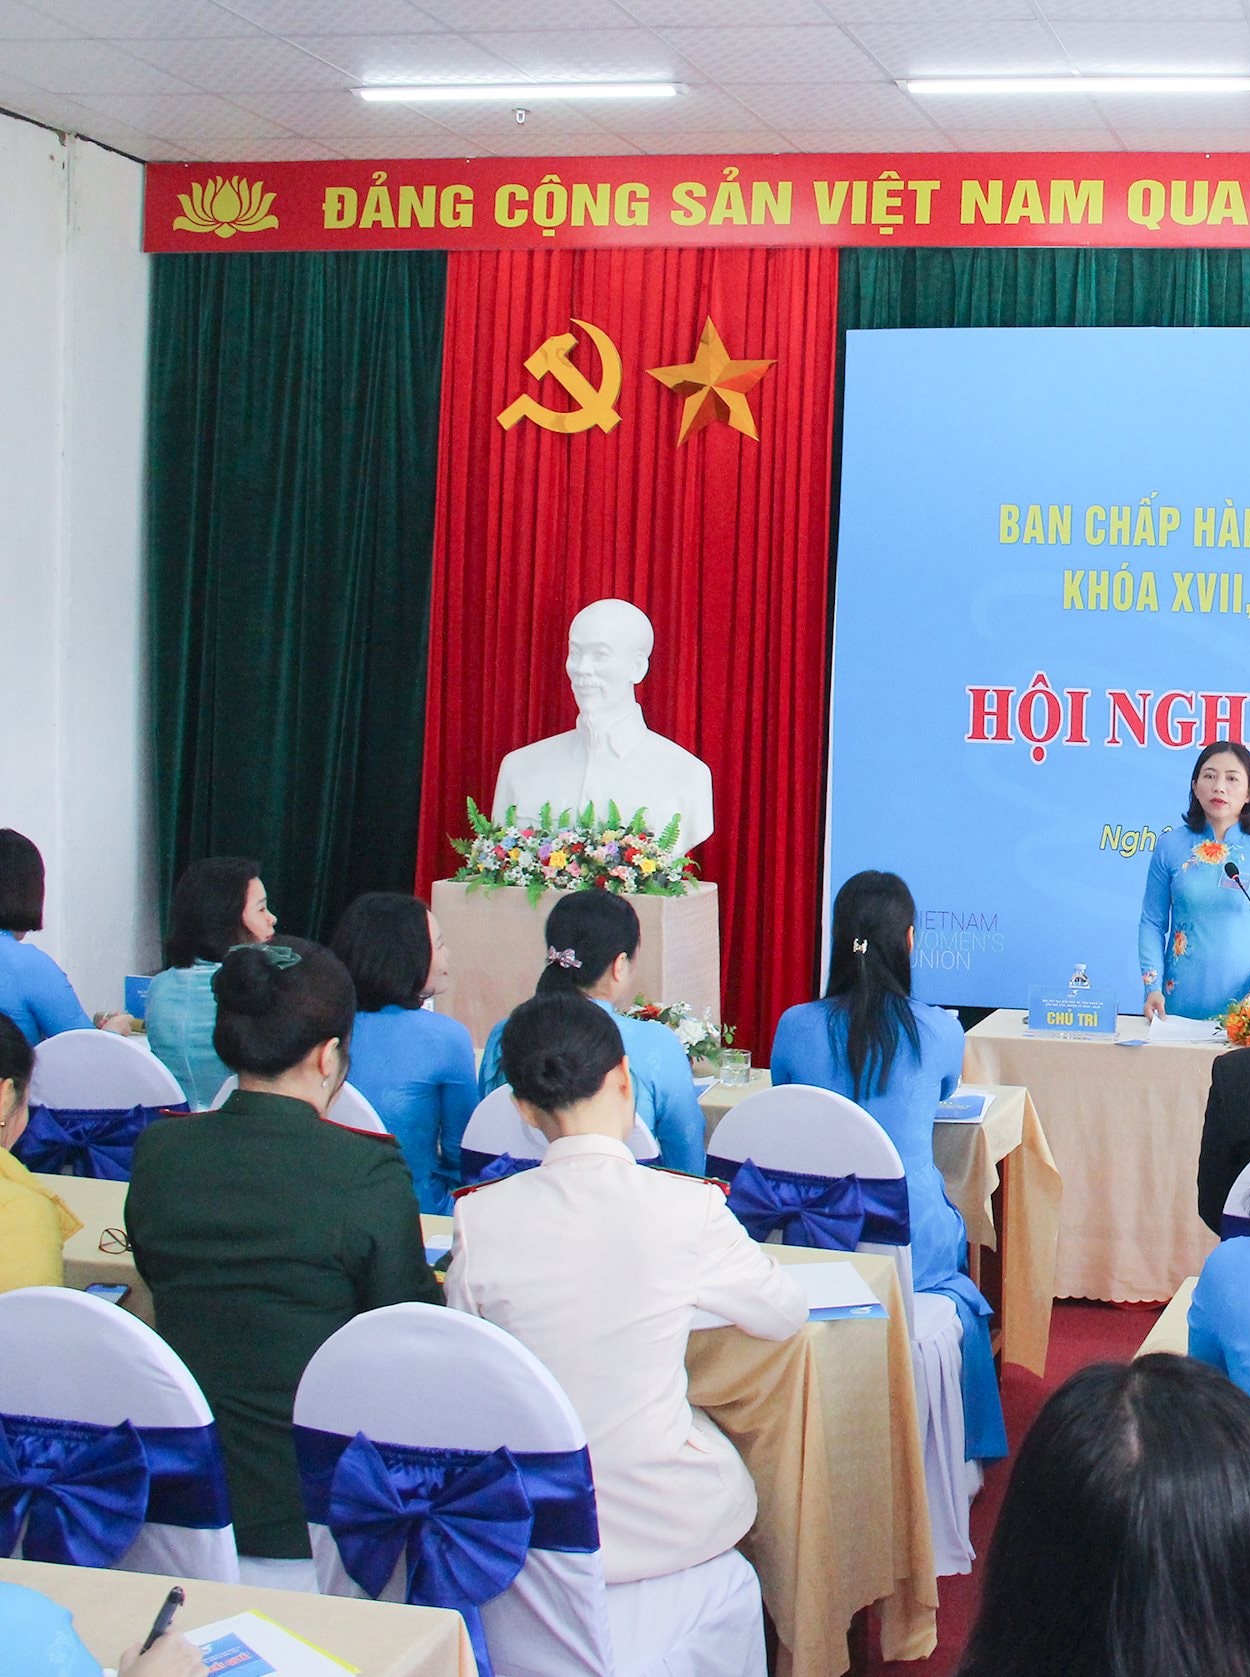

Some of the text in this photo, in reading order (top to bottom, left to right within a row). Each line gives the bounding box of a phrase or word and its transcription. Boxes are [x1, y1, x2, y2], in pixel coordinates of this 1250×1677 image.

[323, 170, 474, 229] ĐẢNG
[495, 174, 650, 237] CỘNG
[671, 166, 793, 227] SẢN
[813, 170, 941, 235] VIỆT
[960, 179, 1105, 225] NAM
[999, 504, 1072, 545] BAN
[1085, 491, 1181, 546] CHẤP
[1063, 562, 1159, 612] KHÓA
[967, 672, 1089, 763] HỘI
[914, 910, 998, 931] IETNAM
[1047, 1008, 1099, 1027] CHỦ TRÌ
